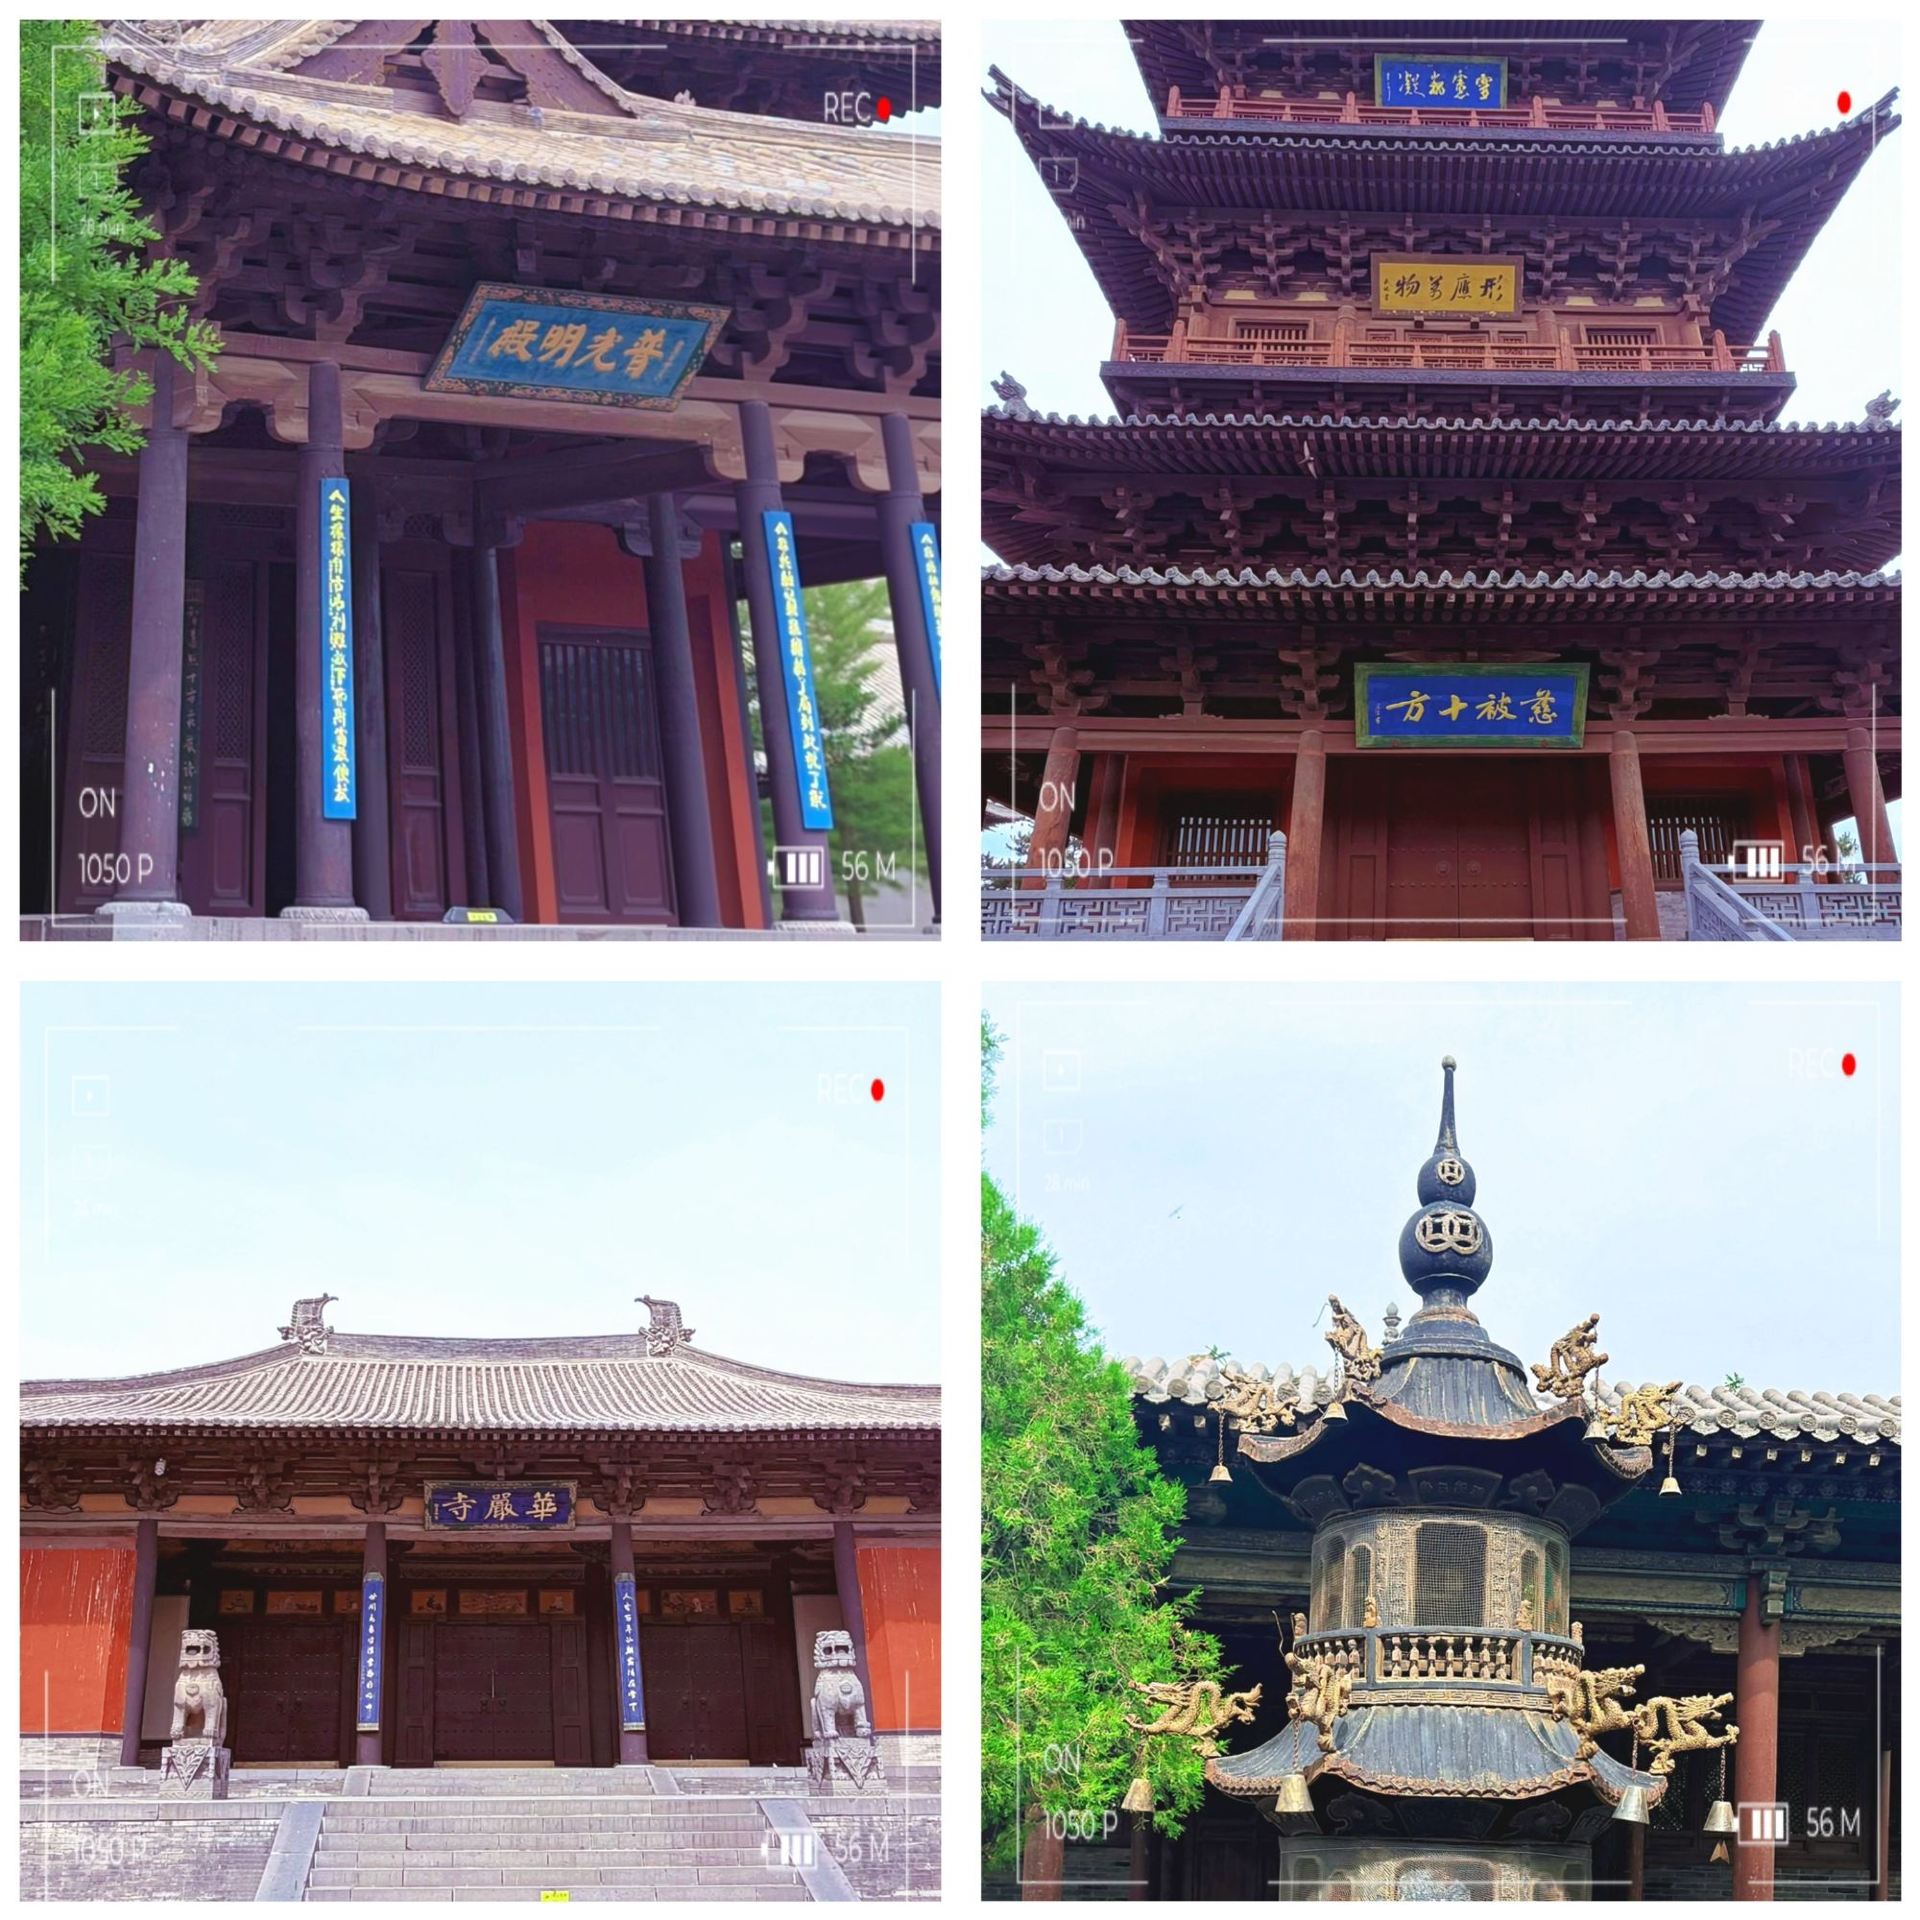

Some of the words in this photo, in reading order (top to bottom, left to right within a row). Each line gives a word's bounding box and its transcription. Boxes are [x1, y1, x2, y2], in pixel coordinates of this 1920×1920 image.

[1385, 688, 1559, 725] 慈被十方
[442, 1491, 558, 1522] 華嚴寺
